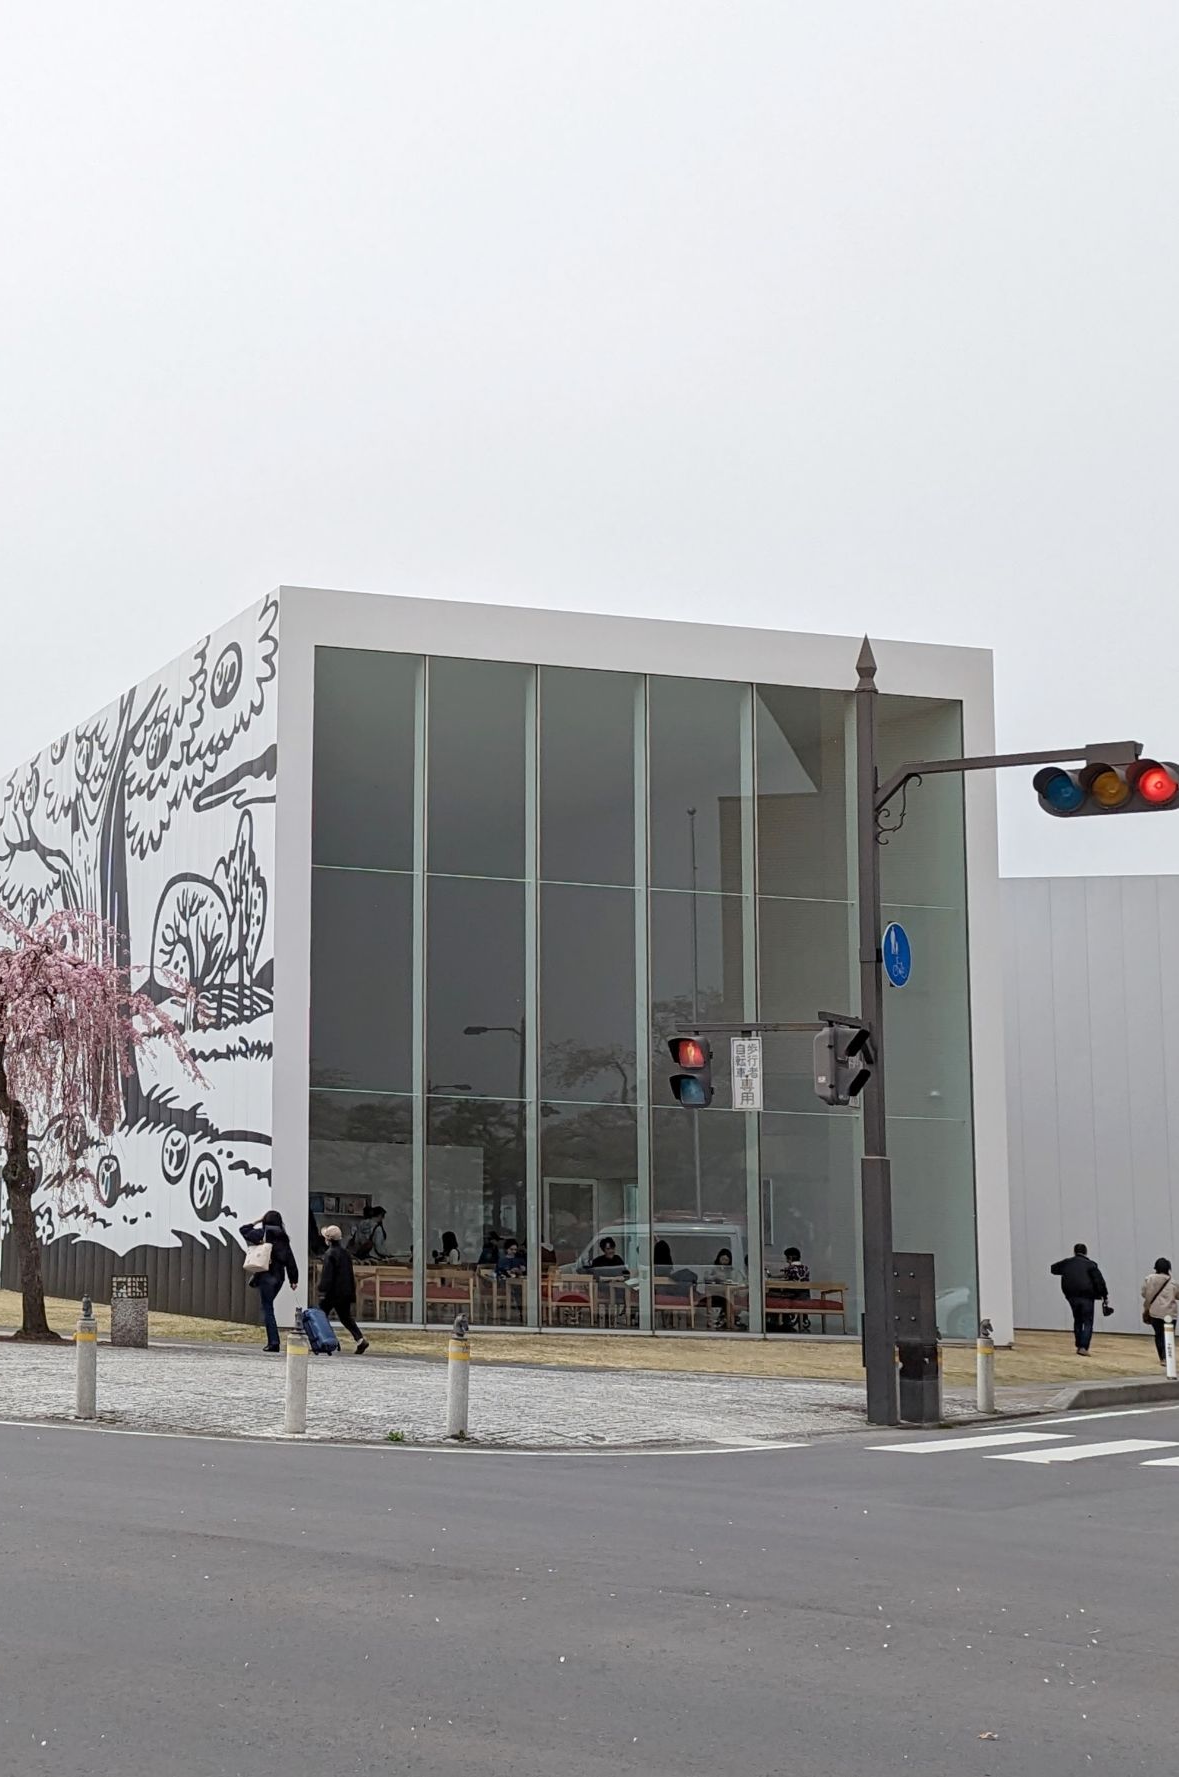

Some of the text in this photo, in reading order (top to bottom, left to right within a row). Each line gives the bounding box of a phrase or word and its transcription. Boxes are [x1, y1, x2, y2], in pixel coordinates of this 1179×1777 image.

[735, 1044, 746, 1079] 自転車
[747, 1043, 758, 1079] 歩行者
[739, 1078, 755, 1106] 専用
